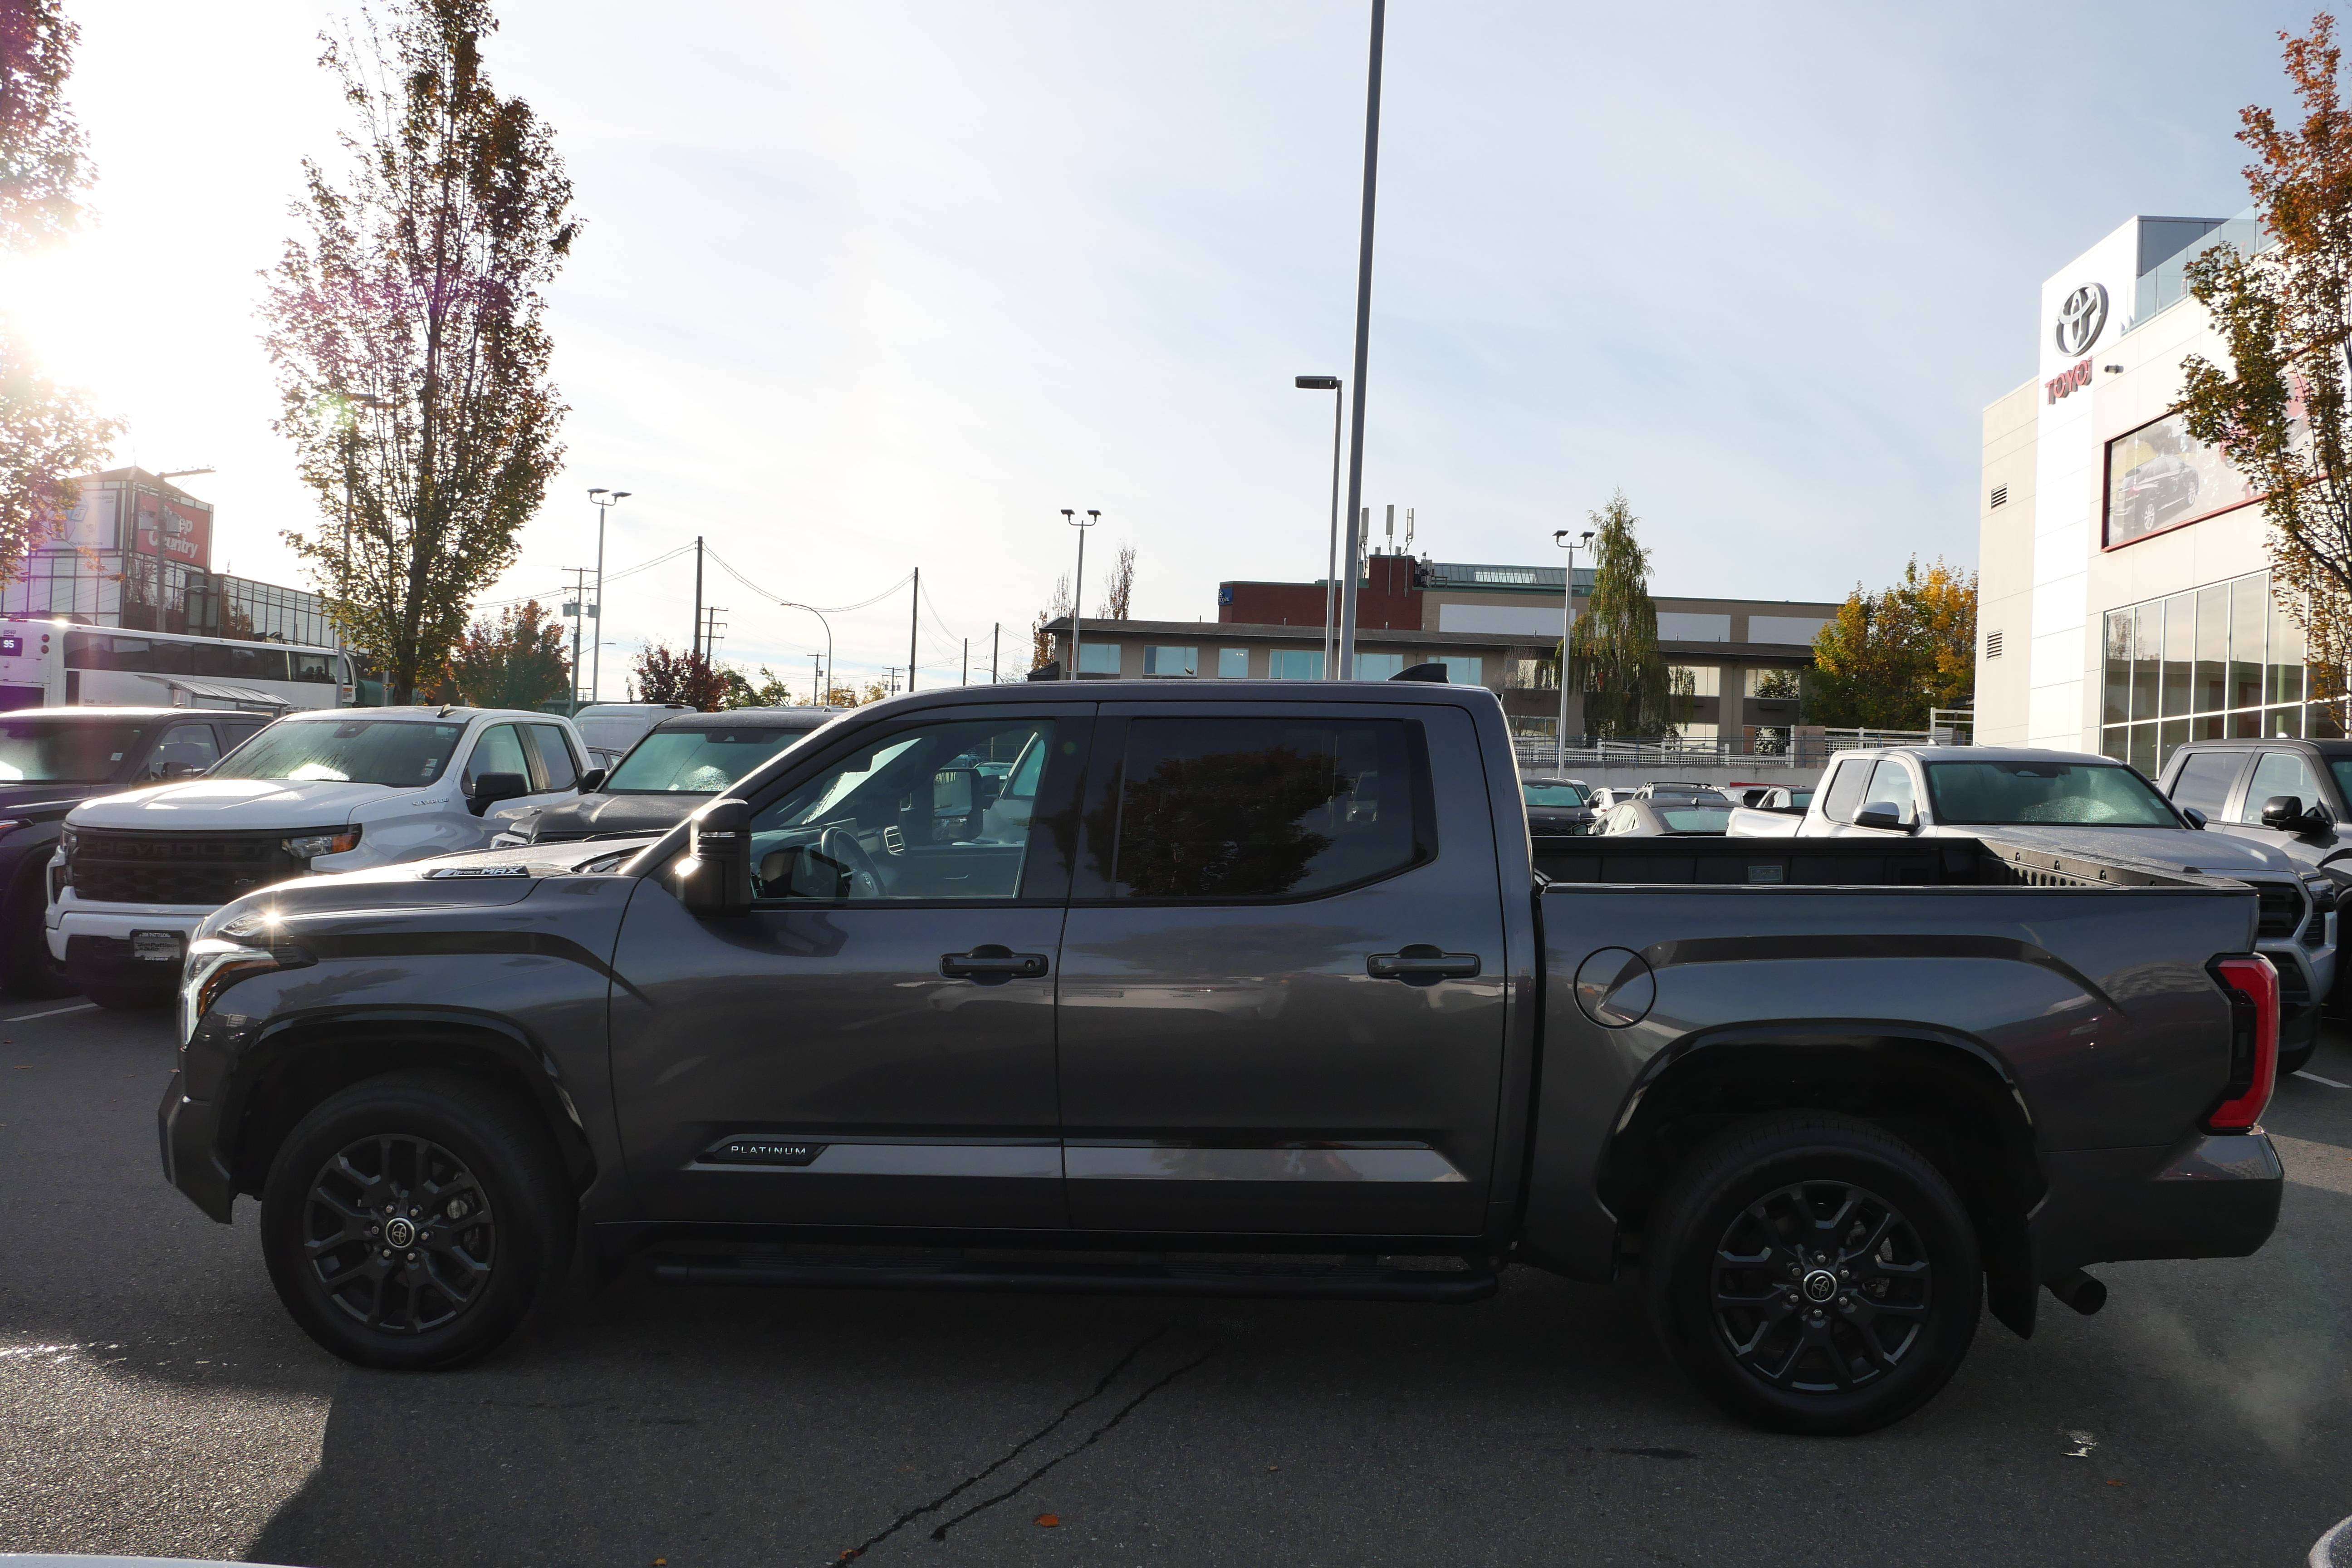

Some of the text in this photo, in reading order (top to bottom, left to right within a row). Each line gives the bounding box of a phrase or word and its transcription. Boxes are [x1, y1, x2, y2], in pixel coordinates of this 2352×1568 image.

[2044, 355, 2092, 405] TOYO
[4, 640, 15, 648] 95
[412, 798, 449, 806] SILVERADO
[79, 841, 269, 856] CHEVROLET
[731, 1146, 805, 1155] PLATINUM
